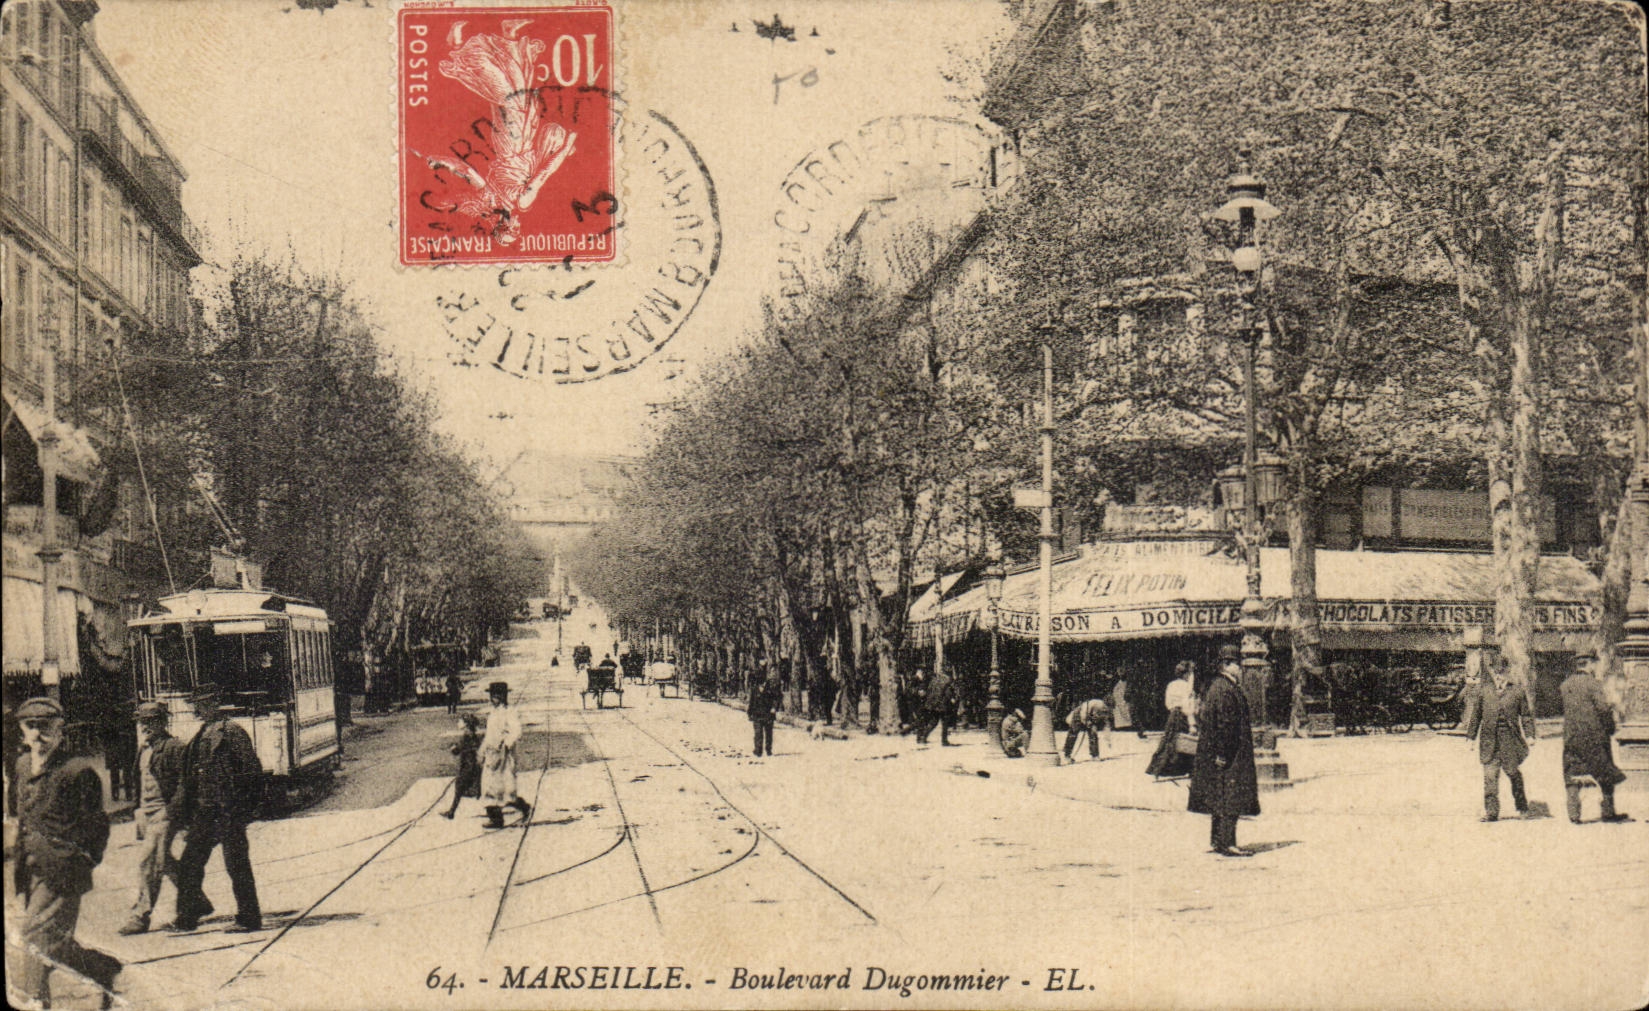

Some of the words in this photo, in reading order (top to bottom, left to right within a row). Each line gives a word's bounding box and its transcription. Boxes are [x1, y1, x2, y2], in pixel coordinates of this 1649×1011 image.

[408, 24, 429, 108] POSTES
[1001, 612, 1090, 633] LIVRSON
[1111, 616, 1122, 630] A
[1141, 608, 1241, 628] DOMICILE
